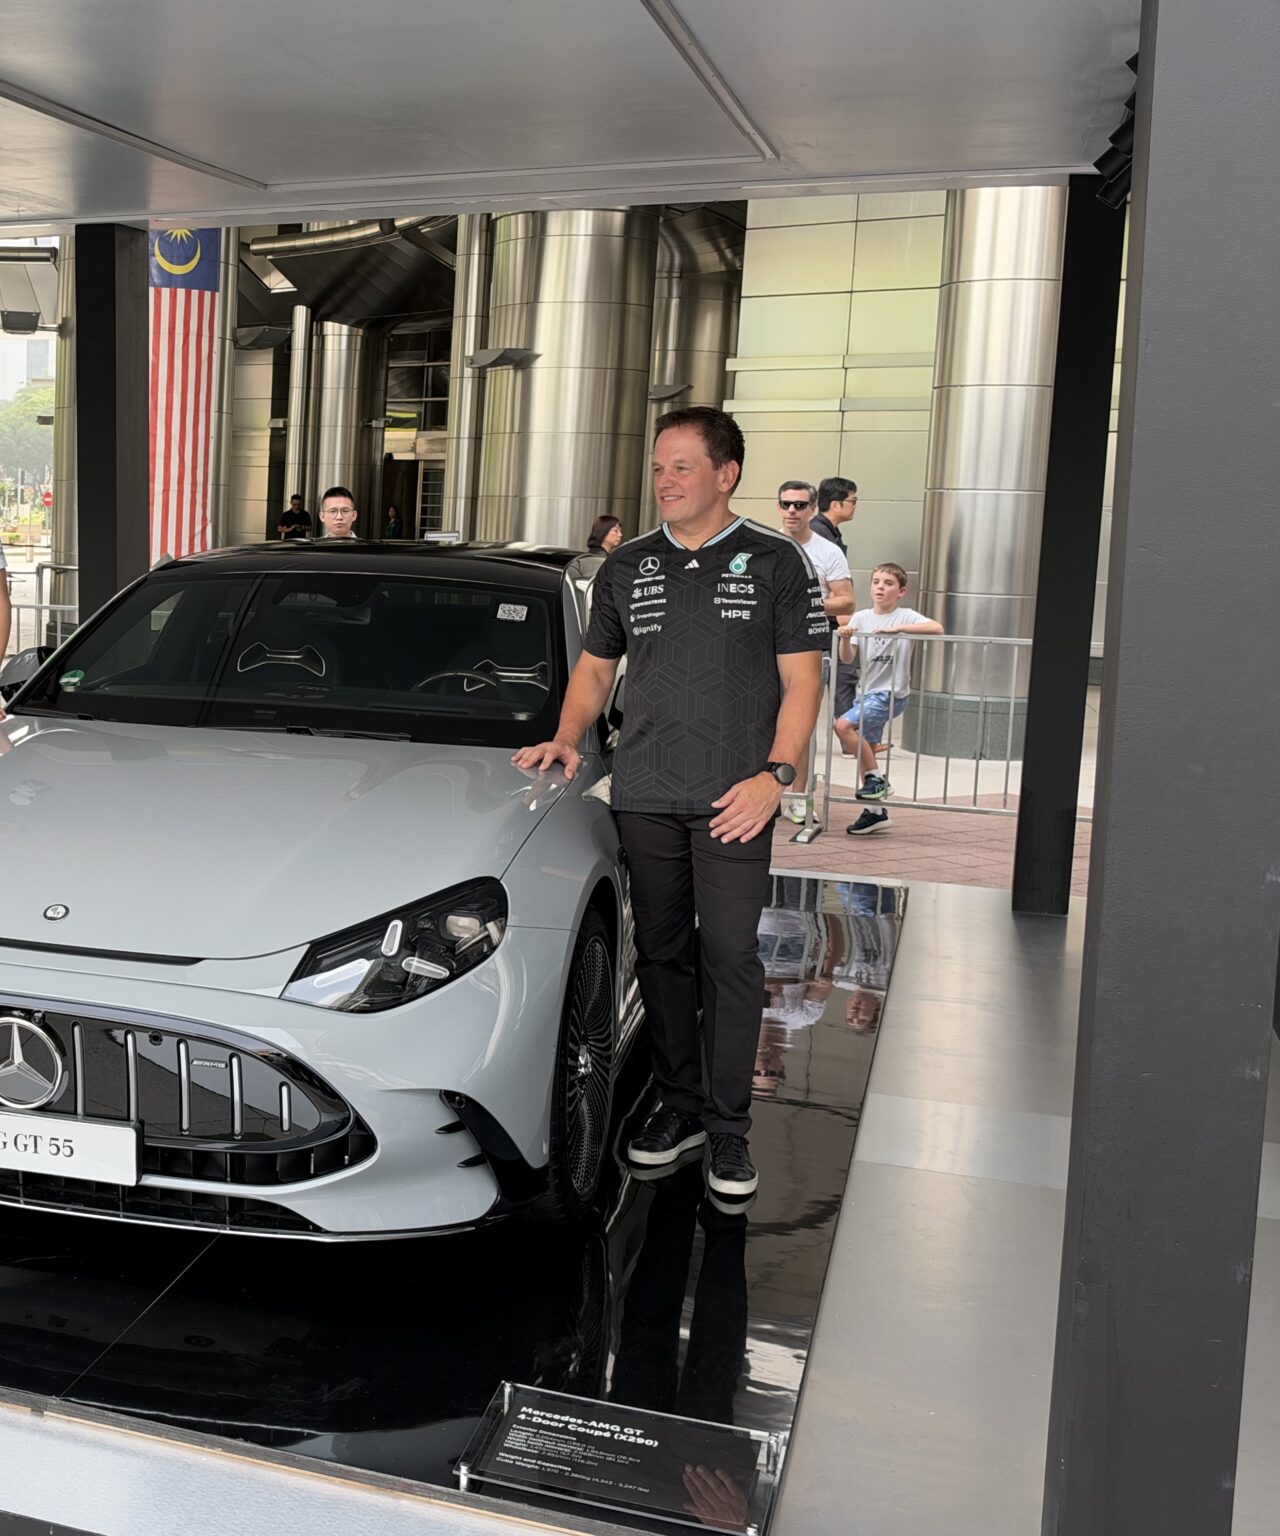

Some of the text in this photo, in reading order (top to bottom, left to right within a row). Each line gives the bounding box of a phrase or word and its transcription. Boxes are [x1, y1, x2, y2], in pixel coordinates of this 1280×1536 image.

[643, 584, 665, 596] UBS
[717, 582, 755, 594] INEOS
[721, 597, 758, 605] TeamViewer
[721, 609, 751, 620] HPE
[13, 1132, 43, 1154] GT
[48, 1137, 75, 1158] 55
[520, 1406, 645, 1436] Mercedes-AMG GT
[517, 1413, 566, 1428] 4-Door
[613, 1432, 659, 1447] (X290)
